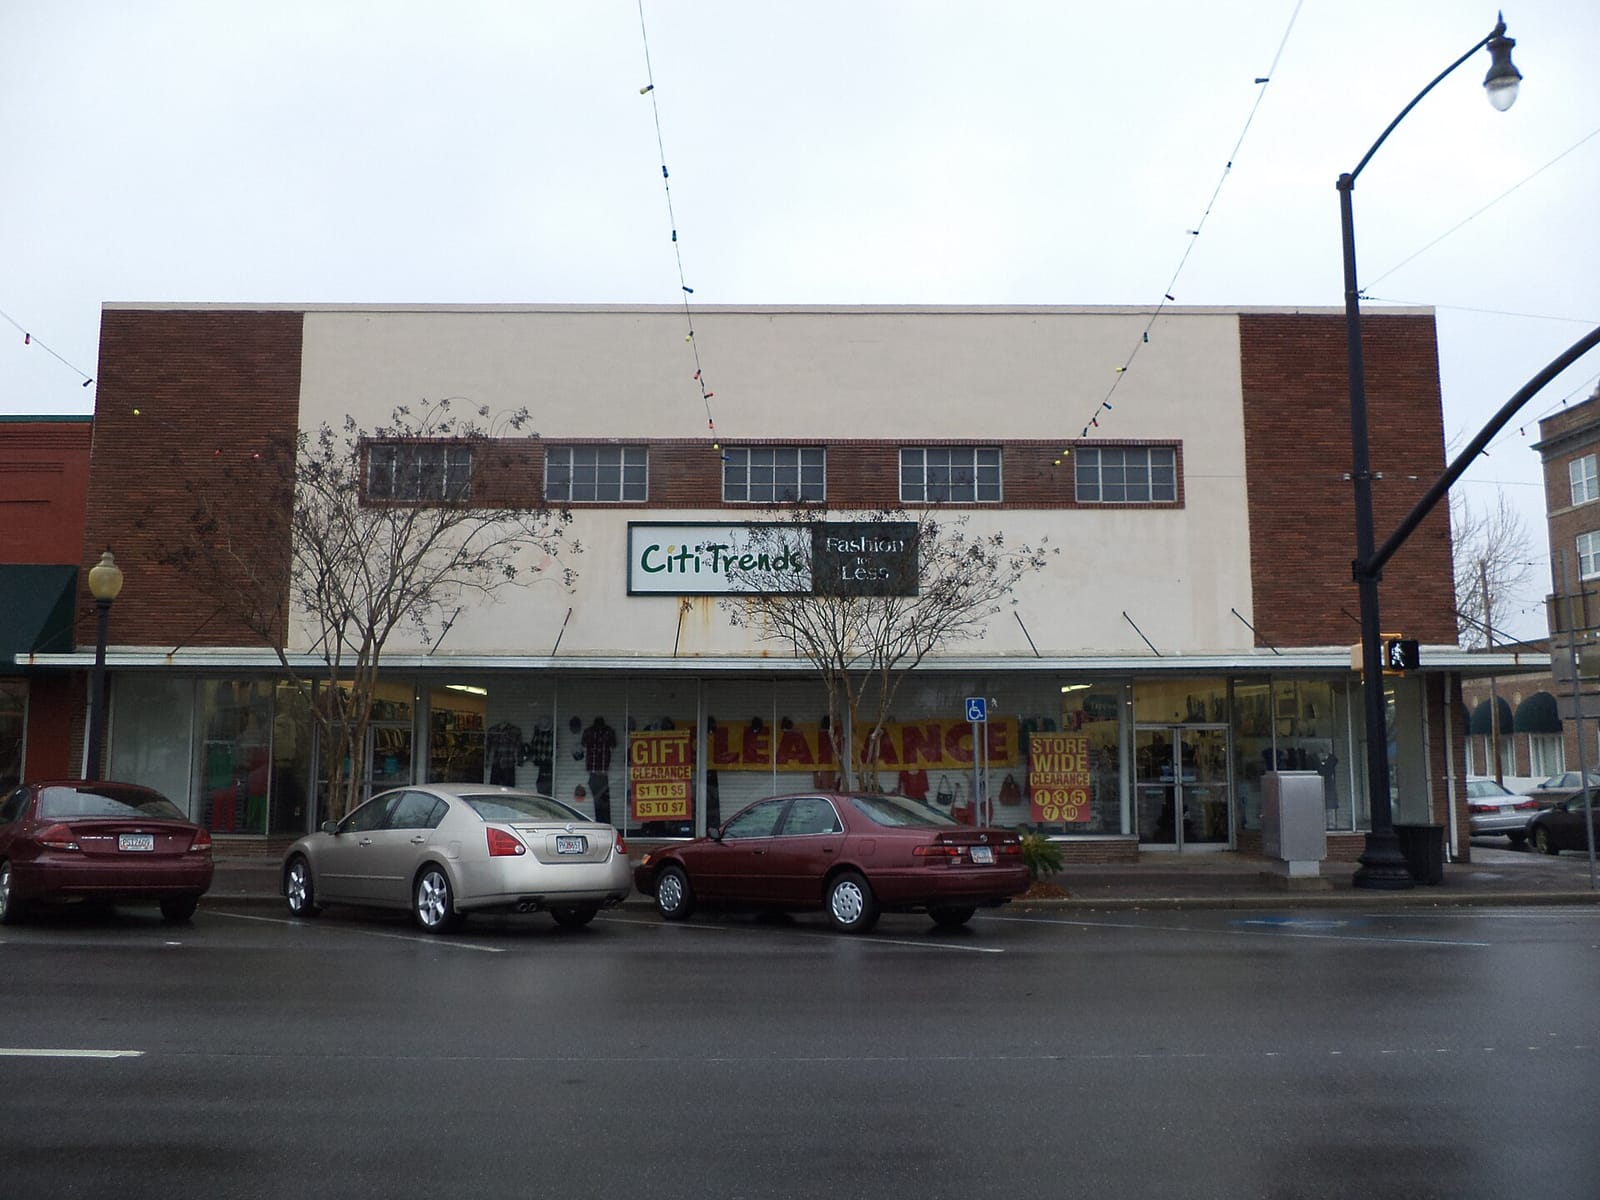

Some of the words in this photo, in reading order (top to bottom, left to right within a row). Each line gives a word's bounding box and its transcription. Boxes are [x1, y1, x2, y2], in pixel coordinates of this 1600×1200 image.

[825, 536, 904, 553] Fashion
[842, 565, 889, 581] Less
[631, 739, 689, 765] GIFT
[1032, 738, 1088, 754] STORE
[1033, 754, 1088, 772] WIDE
[632, 766, 690, 780] CLEARANCE
[1031, 773, 1090, 785] CLEARANCE
[639, 786, 650, 797] $1
[655, 785, 668, 796] TO
[671, 784, 683, 795] $5
[640, 803, 652, 814] $5
[656, 802, 668, 813] TO
[672, 801, 684, 812] $7
